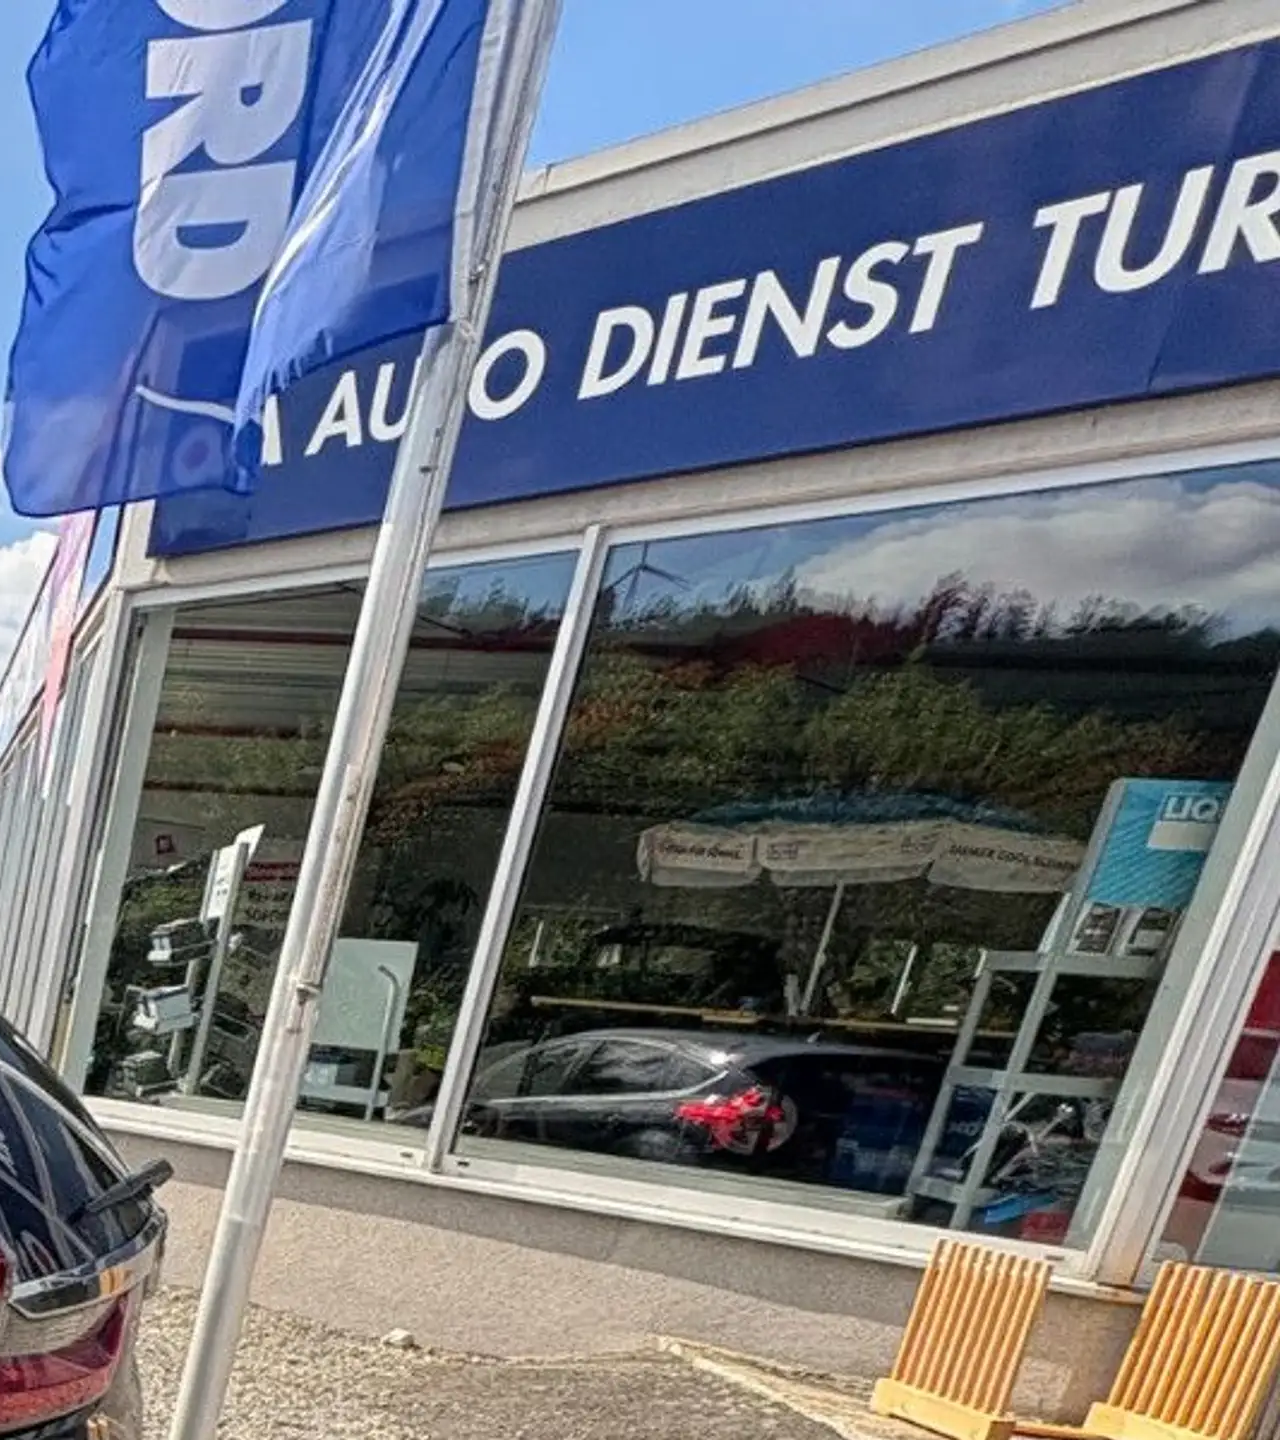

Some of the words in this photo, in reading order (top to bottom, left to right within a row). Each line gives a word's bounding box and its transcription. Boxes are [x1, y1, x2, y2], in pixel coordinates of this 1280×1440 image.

[133, 0, 313, 300] RD
[303, 328, 547, 458] AUO
[576, 221, 985, 400] DIENST
[1163, 795, 1226, 820] LIQ
